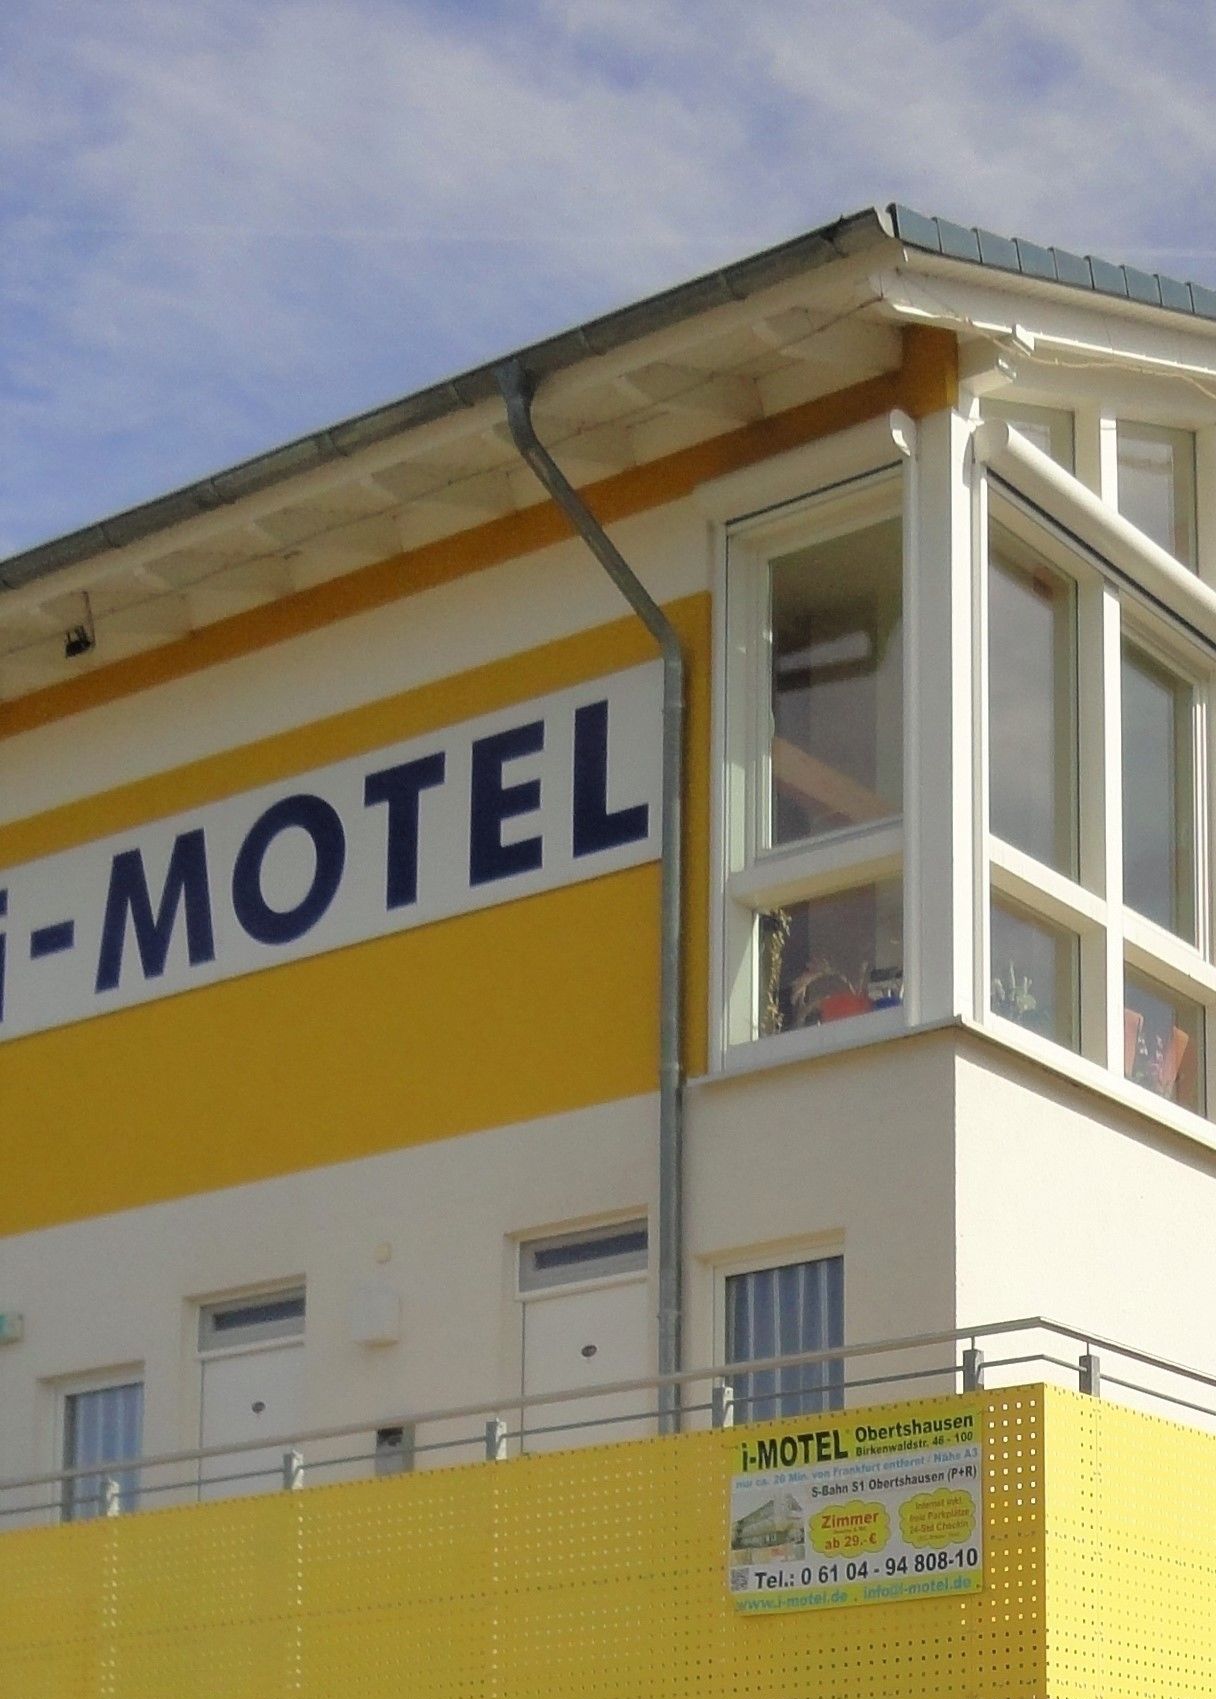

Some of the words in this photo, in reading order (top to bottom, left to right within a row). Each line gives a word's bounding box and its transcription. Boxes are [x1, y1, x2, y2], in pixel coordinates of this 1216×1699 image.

[0, 700, 649, 1023] -MOTEL
[855, 1414, 974, 1444] Obertshausen
[855, 1438, 929, 1458] Birkenwaldstr.
[955, 1431, 974, 1444] 100
[741, 1429, 848, 1473] i-MOTEL
[736, 1479, 753, 1489] nur
[811, 1470, 830, 1480] von
[832, 1462, 881, 1478] Frankfurt
[883, 1455, 925, 1471] entfernt
[964, 1447, 978, 1458] A3
[811, 1483, 849, 1498] S-Bahn
[852, 1480, 865, 1493] S1
[868, 1472, 945, 1491] Obertshausen
[947, 1465, 978, 1483] (P+R)
[821, 1512, 879, 1529] Zimmer
[825, 1537, 840, 1550] ab
[754, 1572, 795, 1590] Tel.:
[801, 1568, 812, 1585] 0
[818, 1564, 838, 1584] 61
[846, 1561, 868, 1581] 04
[886, 1556, 908, 1576] 94
[914, 1547, 979, 1572] 808-10
[735, 1590, 848, 1612] www.i-motel.de
